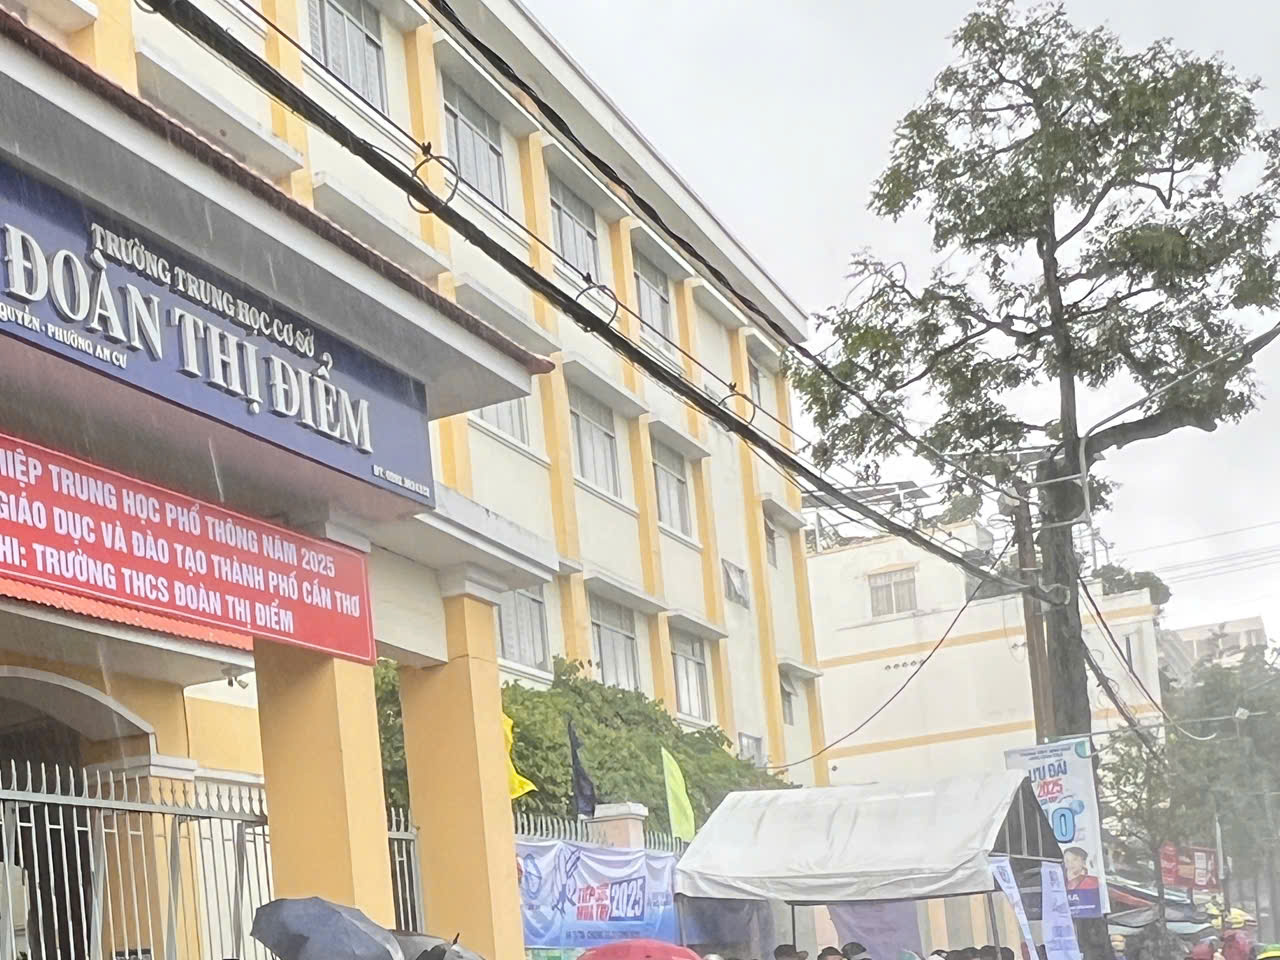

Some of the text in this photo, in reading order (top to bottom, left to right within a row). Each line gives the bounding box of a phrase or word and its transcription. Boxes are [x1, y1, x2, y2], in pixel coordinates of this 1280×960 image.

[2, 222, 374, 454] ĐOÀN THỊ ĐIỂM
[91, 222, 315, 357] TRƯỜNG TRUNG HỌC CƠ SỞ
[48, 463, 117, 511] TRUNG
[122, 488, 161, 525] HỌC
[166, 502, 201, 536] PHỔ
[205, 515, 259, 553] THÔNG
[301, 548, 336, 578] 2025
[53, 507, 96, 545] DỤC
[100, 517, 128, 553] VÀ
[131, 529, 169, 565] ĐÀO
[173, 542, 208, 578] TẠO
[211, 554, 265, 592] THÀNH
[269, 570, 298, 601] PHỐ
[334, 590, 361, 618] THƠ
[32, 541, 116, 590] TRƯỜNG
[121, 567, 169, 602] THCS
[173, 579, 221, 617] ĐOÀN
[225, 594, 251, 630] THỊ
[255, 600, 294, 634] ĐIỂM
[611, 879, 645, 917] 2025
